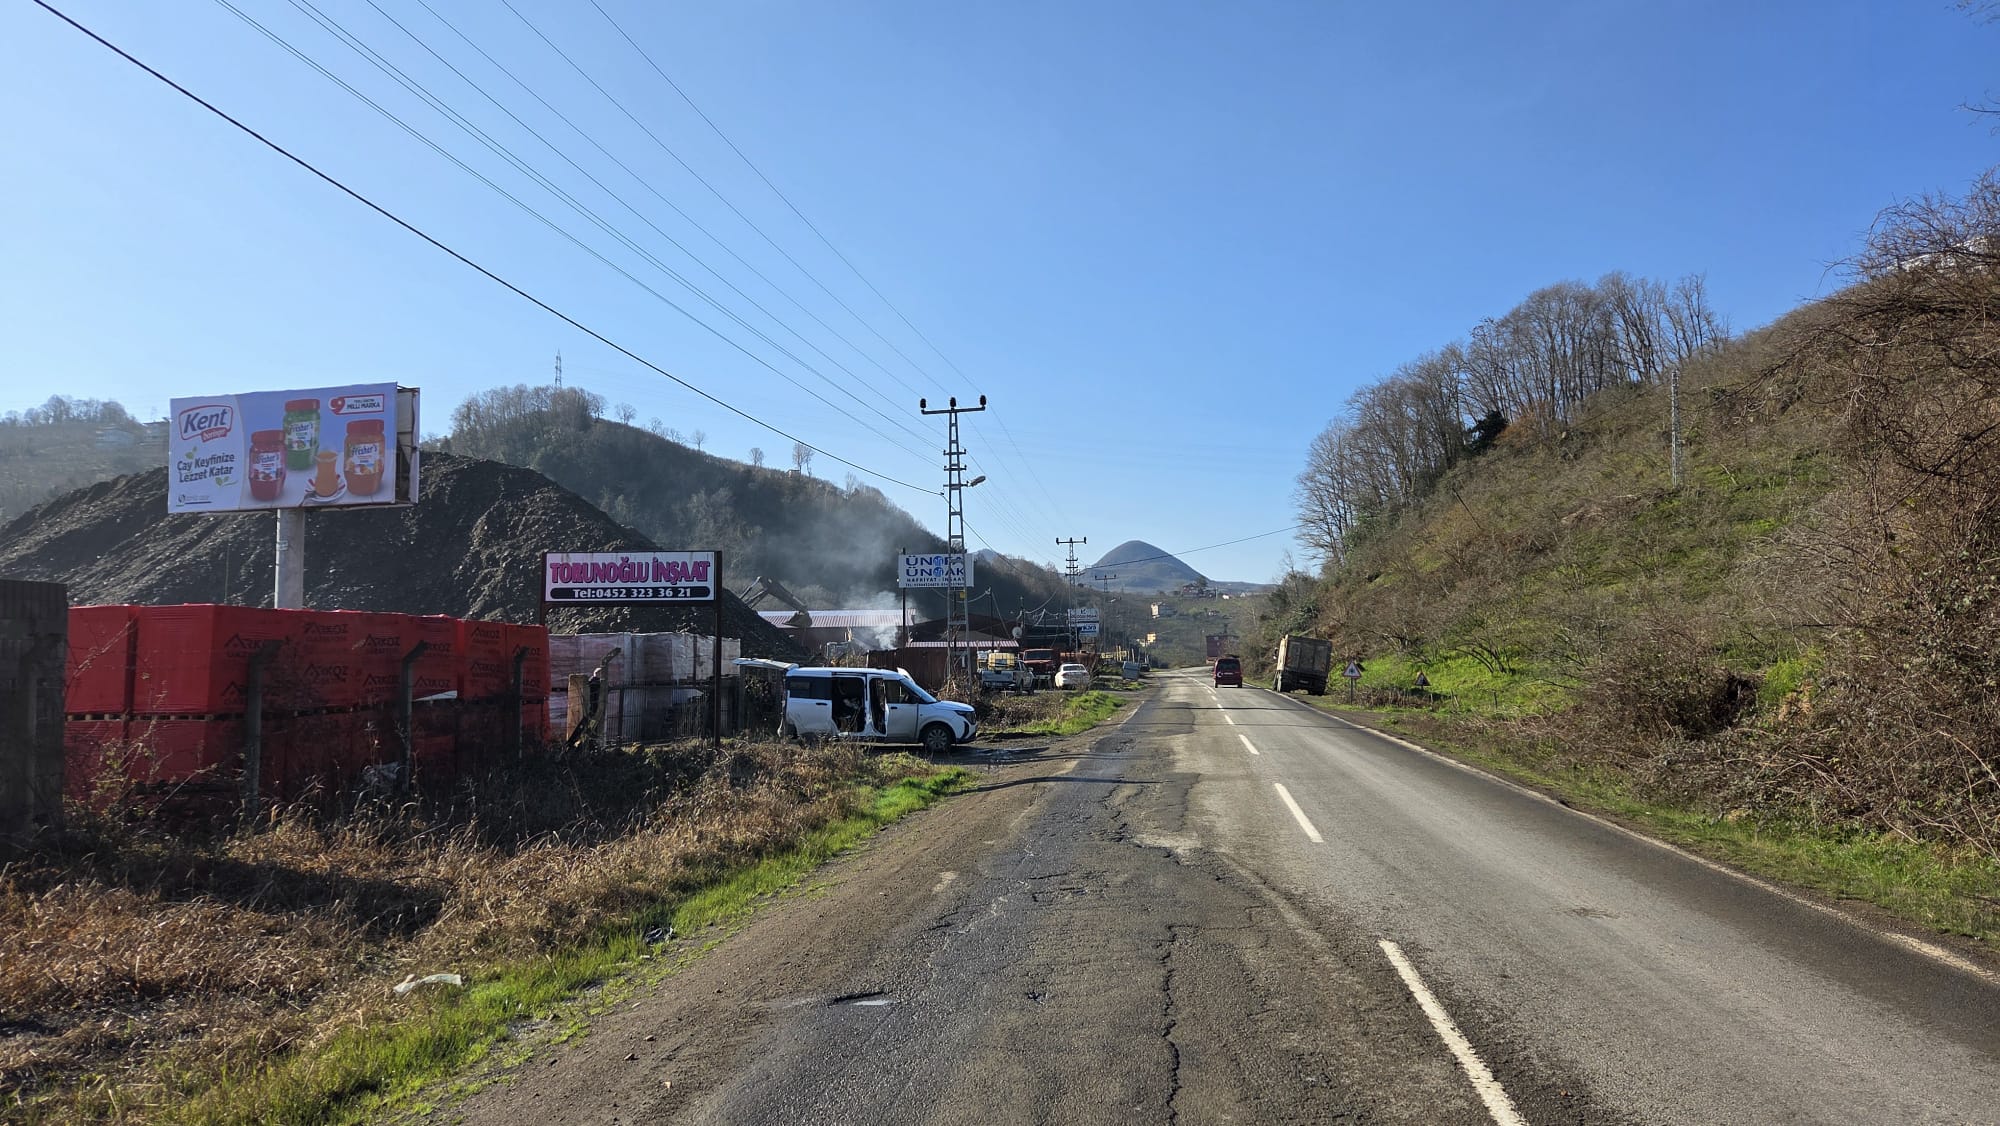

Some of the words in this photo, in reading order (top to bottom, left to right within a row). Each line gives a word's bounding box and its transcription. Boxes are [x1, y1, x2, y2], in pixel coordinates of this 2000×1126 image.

[184, 408, 227, 434] Kent
[178, 469, 207, 483] Lezzet
[209, 466, 233, 478] Katar
[550, 557, 649, 584] TORUNOĞLU
[652, 557, 710, 585] İNŞAAT
[631, 588, 653, 598] 323
[659, 587, 673, 597] 36
[678, 587, 690, 597] 21
